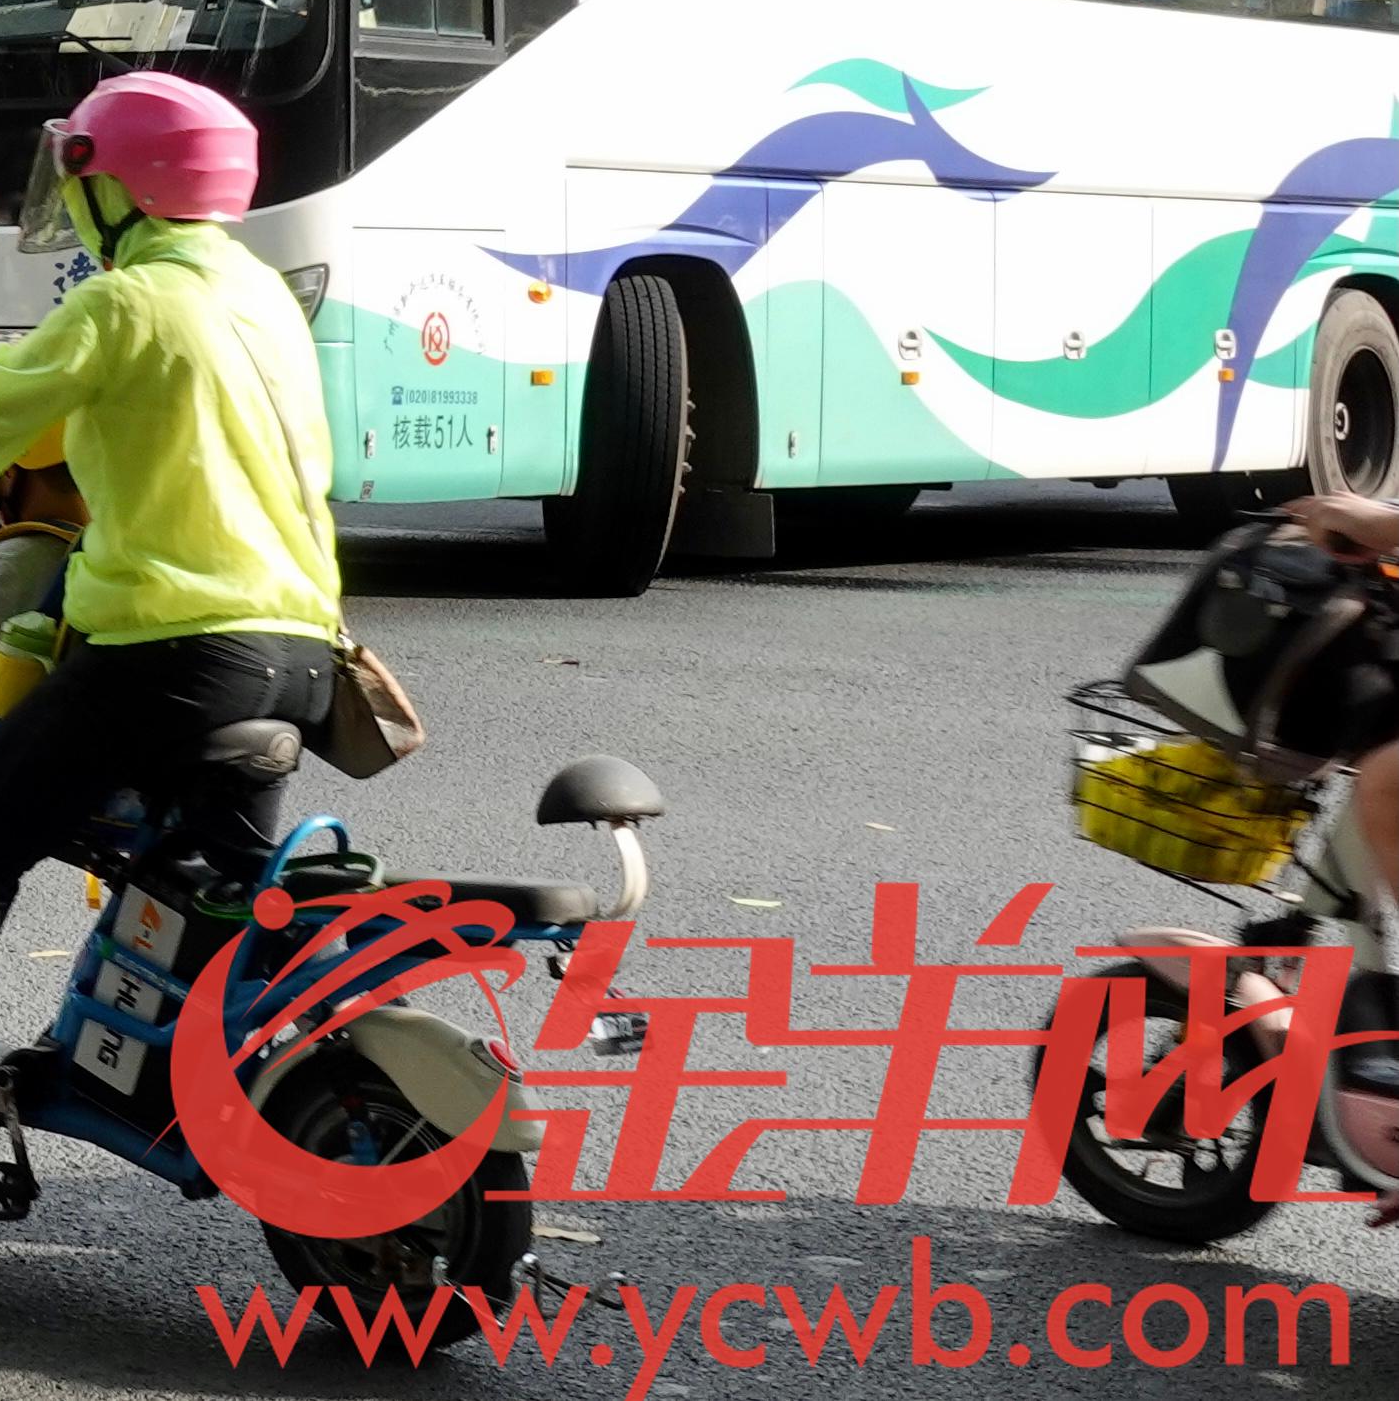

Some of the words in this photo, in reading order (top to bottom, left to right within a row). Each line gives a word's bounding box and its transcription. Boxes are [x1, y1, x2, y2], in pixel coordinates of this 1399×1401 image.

[405, 389, 479, 406] (020)81993338
[392, 414, 474, 450] 核载51人
